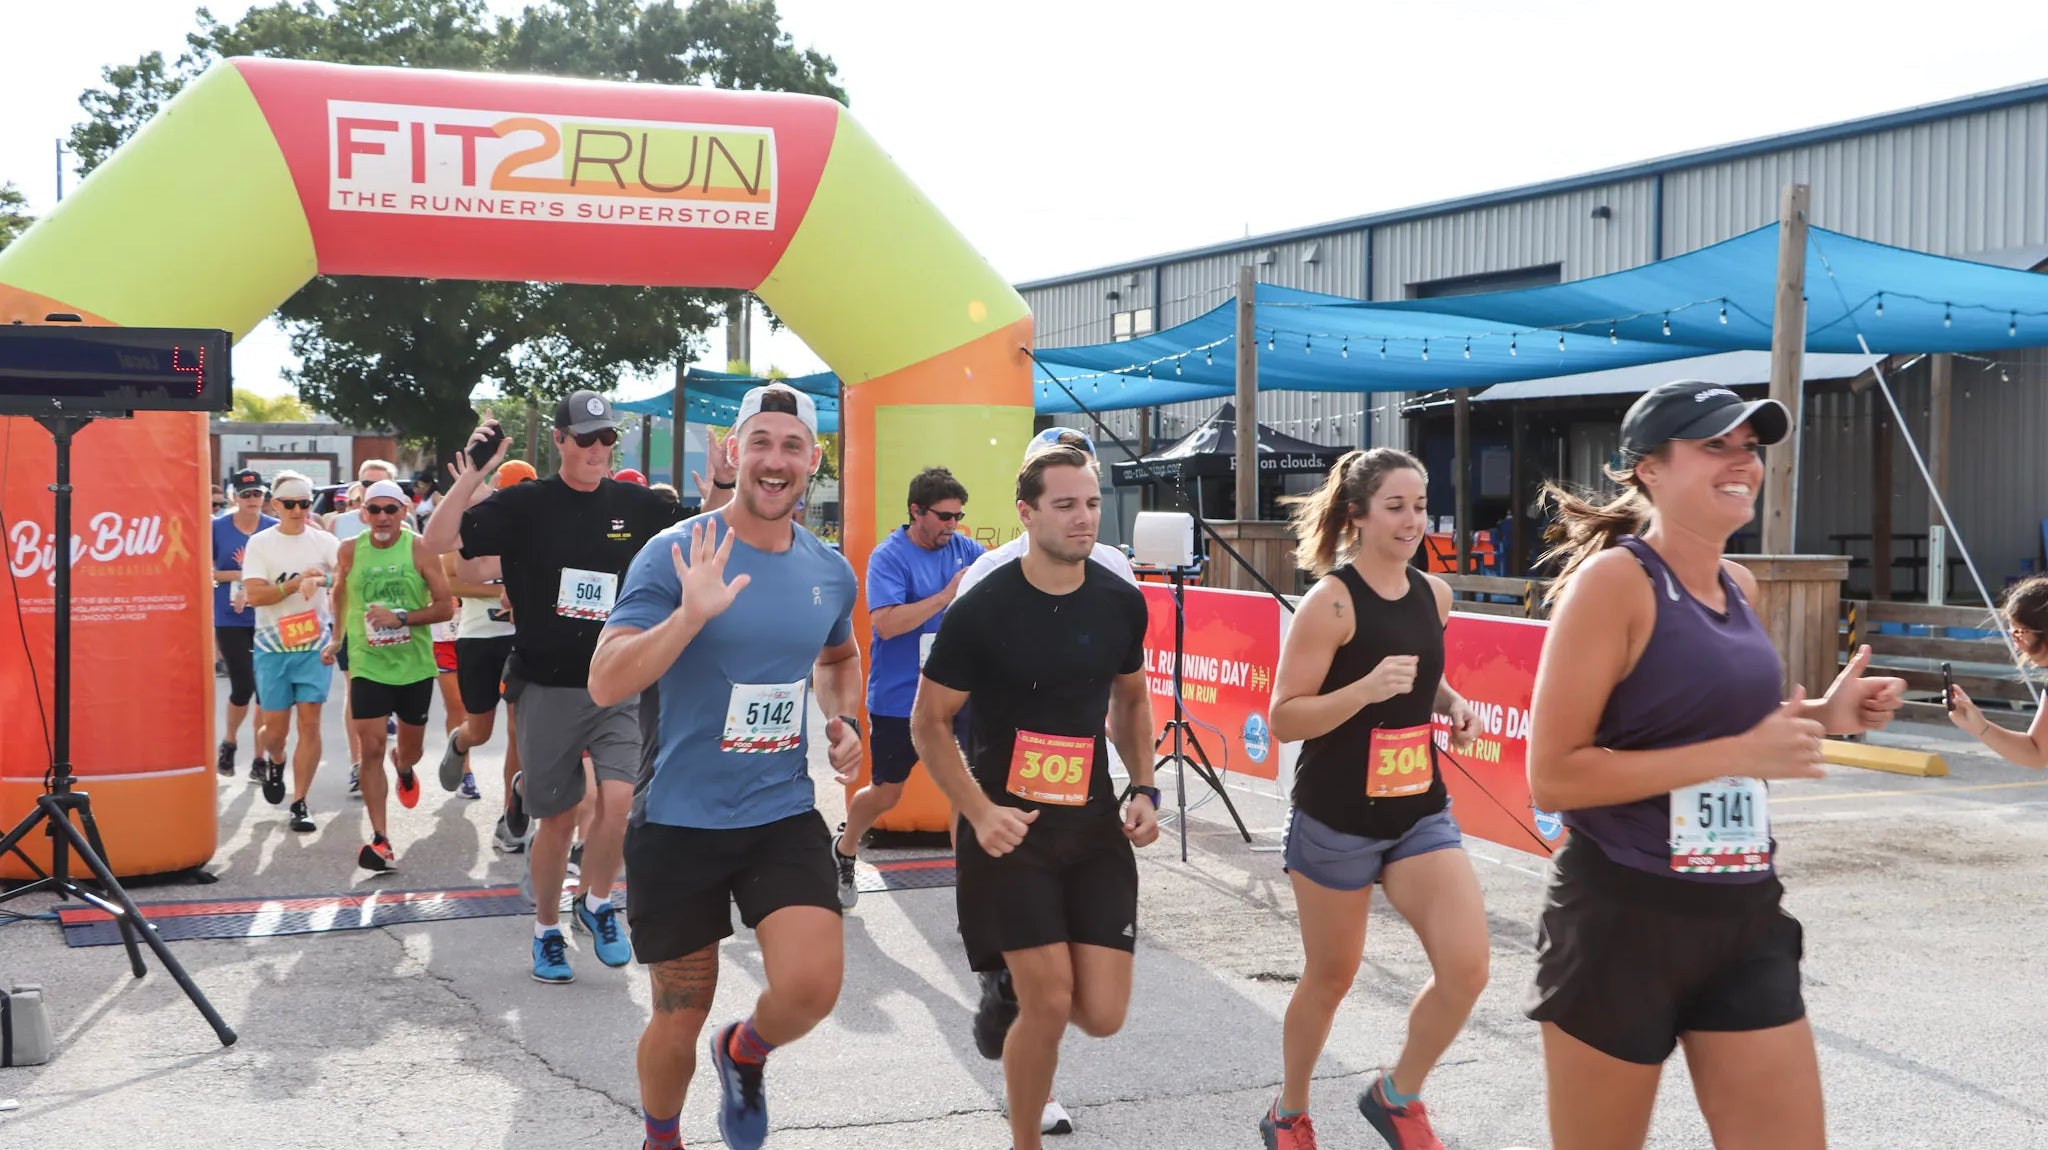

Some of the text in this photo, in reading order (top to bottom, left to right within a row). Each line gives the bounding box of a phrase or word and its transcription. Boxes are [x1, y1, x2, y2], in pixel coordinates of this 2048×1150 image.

[337, 190, 769, 226] THE RUNNER'S SUPERSTORE
[173, 346, 205, 393] 4
[1260, 453, 1326, 469] on clouds.
[89, 511, 163, 562] Bill
[82, 565, 161, 577] FOUNDATION
[576, 582, 602, 601] 504
[285, 619, 314, 638] 314
[1220, 659, 1250, 688] DAY
[1152, 677, 1174, 697] CLUB
[1182, 682, 1195, 702] UN
[1196, 685, 1217, 705] RUN
[745, 700, 795, 726] 5142
[1505, 707, 1530, 740] DA
[1375, 743, 1428, 776] 304
[1476, 737, 1501, 764] RUN
[1019, 750, 1085, 784] 305
[1698, 791, 1754, 829] 5141
